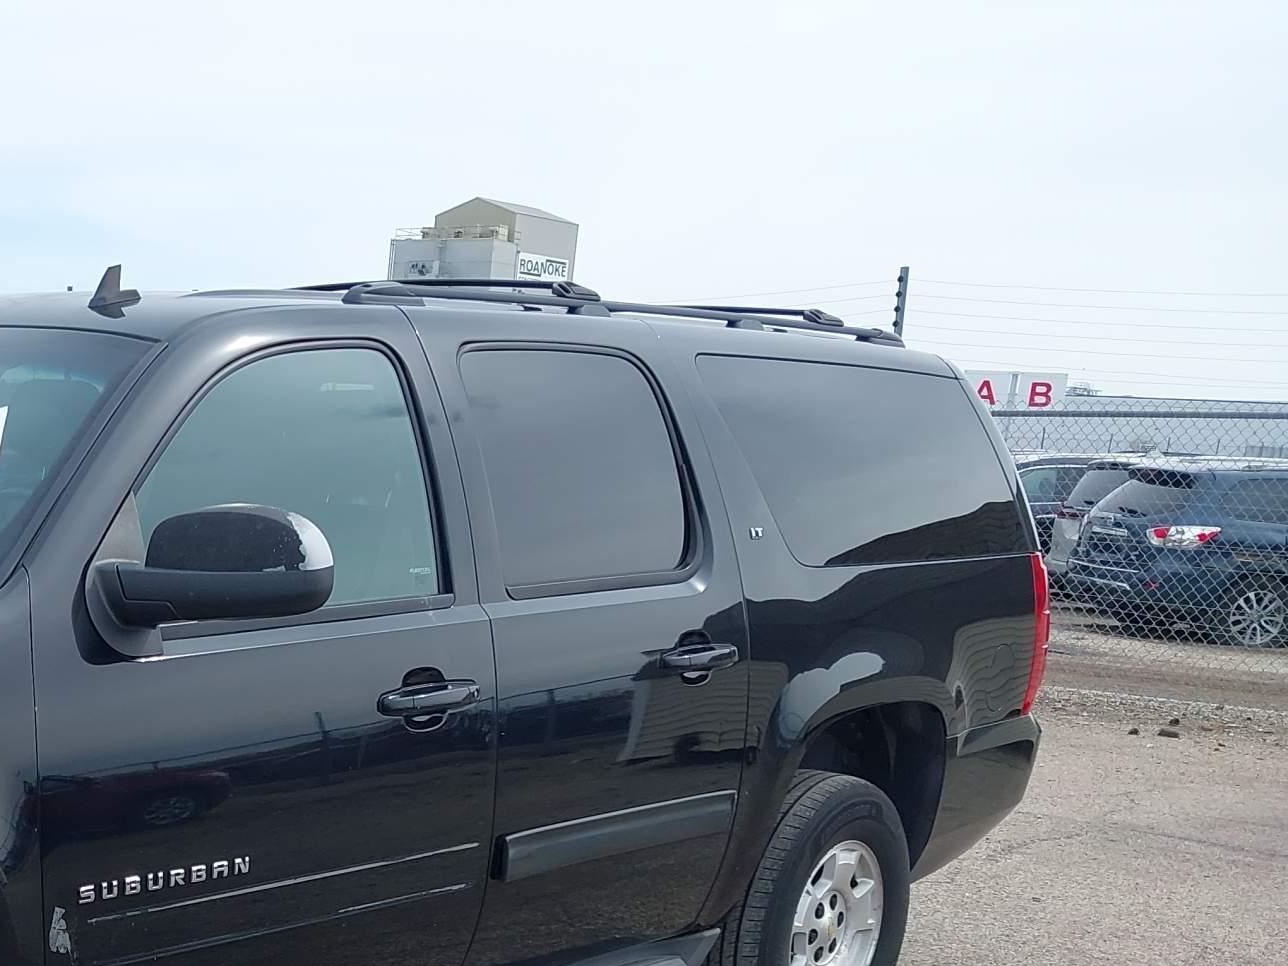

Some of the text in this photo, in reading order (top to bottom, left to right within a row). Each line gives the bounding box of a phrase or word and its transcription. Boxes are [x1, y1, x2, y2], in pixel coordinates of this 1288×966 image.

[519, 258, 567, 278] ROANOKE
[977, 380, 996, 405] A
[1028, 381, 1053, 408] B
[78, 856, 250, 904] SUBURBAN
